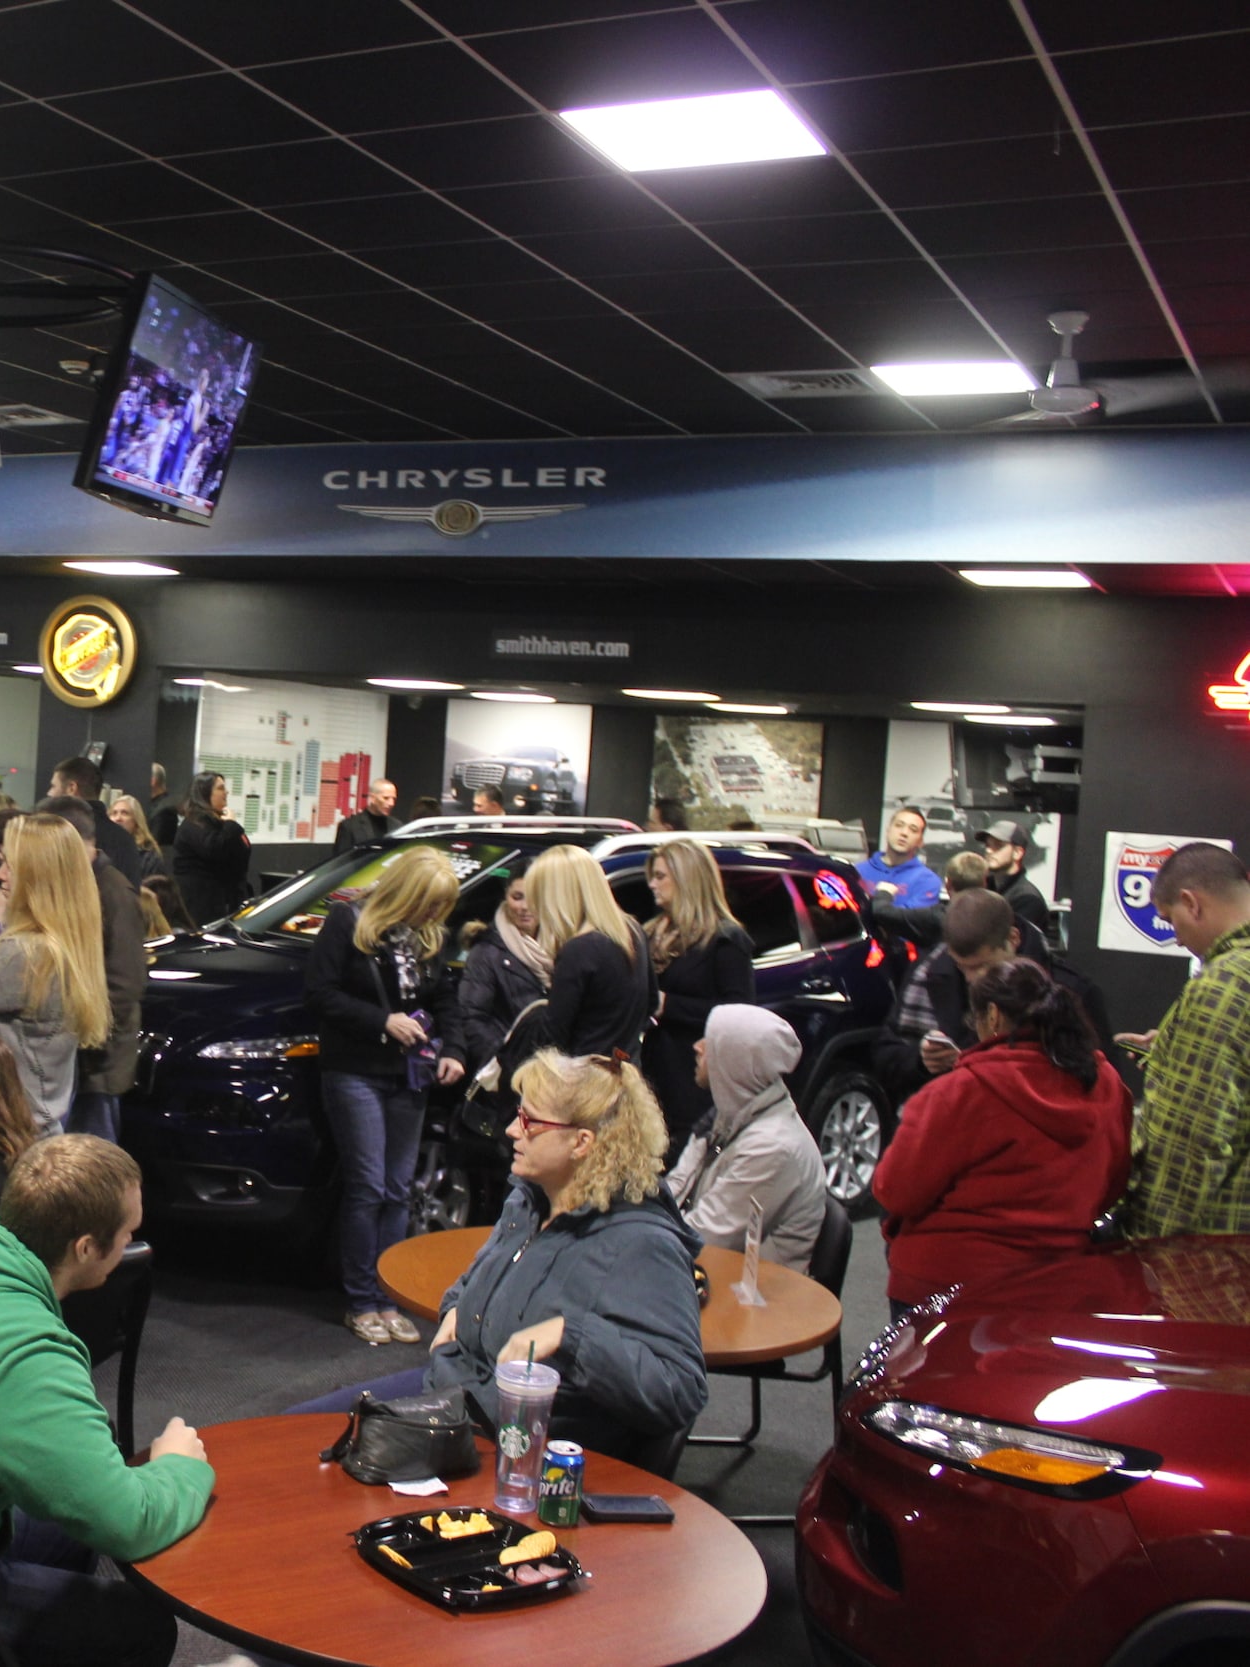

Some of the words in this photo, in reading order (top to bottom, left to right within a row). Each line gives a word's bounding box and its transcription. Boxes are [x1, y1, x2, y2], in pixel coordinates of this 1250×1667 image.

[322, 467, 607, 490] CHRYSLER
[495, 635, 630, 657] smithhaven.com
[1123, 873, 1152, 908] 9
[538, 1478, 575, 1498] prite
